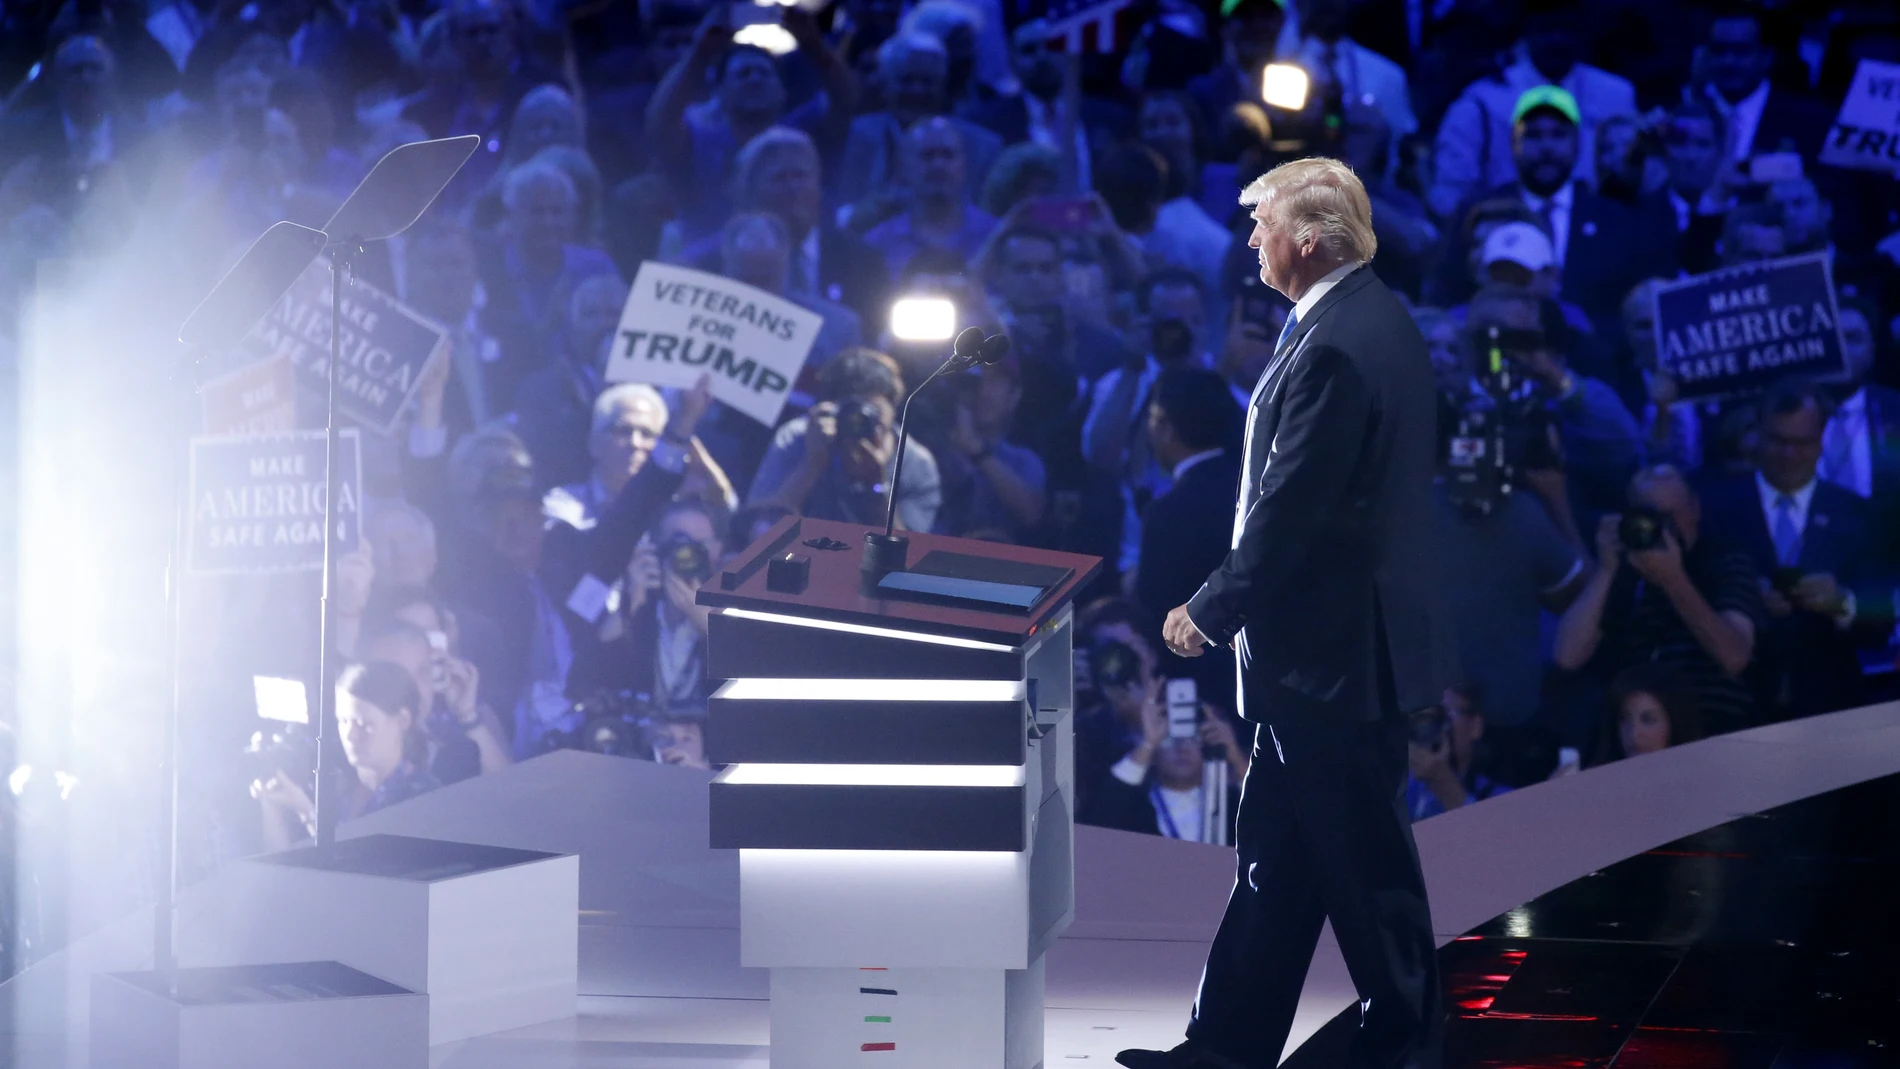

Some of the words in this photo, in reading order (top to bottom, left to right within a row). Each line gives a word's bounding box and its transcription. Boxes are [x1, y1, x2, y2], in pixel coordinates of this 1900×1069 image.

[654, 279, 797, 342] VETERANS
[1708, 283, 1770, 314] MAKE
[271, 295, 412, 394] MERICA
[687, 314, 736, 341] FOR
[1664, 301, 1834, 360] AMERICA
[621, 330, 789, 394] TRUMP
[1678, 352, 1740, 382] SAFE
[1748, 337, 1826, 370] AGAIN
[249, 453, 306, 478] MAKE
[196, 479, 357, 523] AMERICA
[208, 522, 266, 549] SAFE
